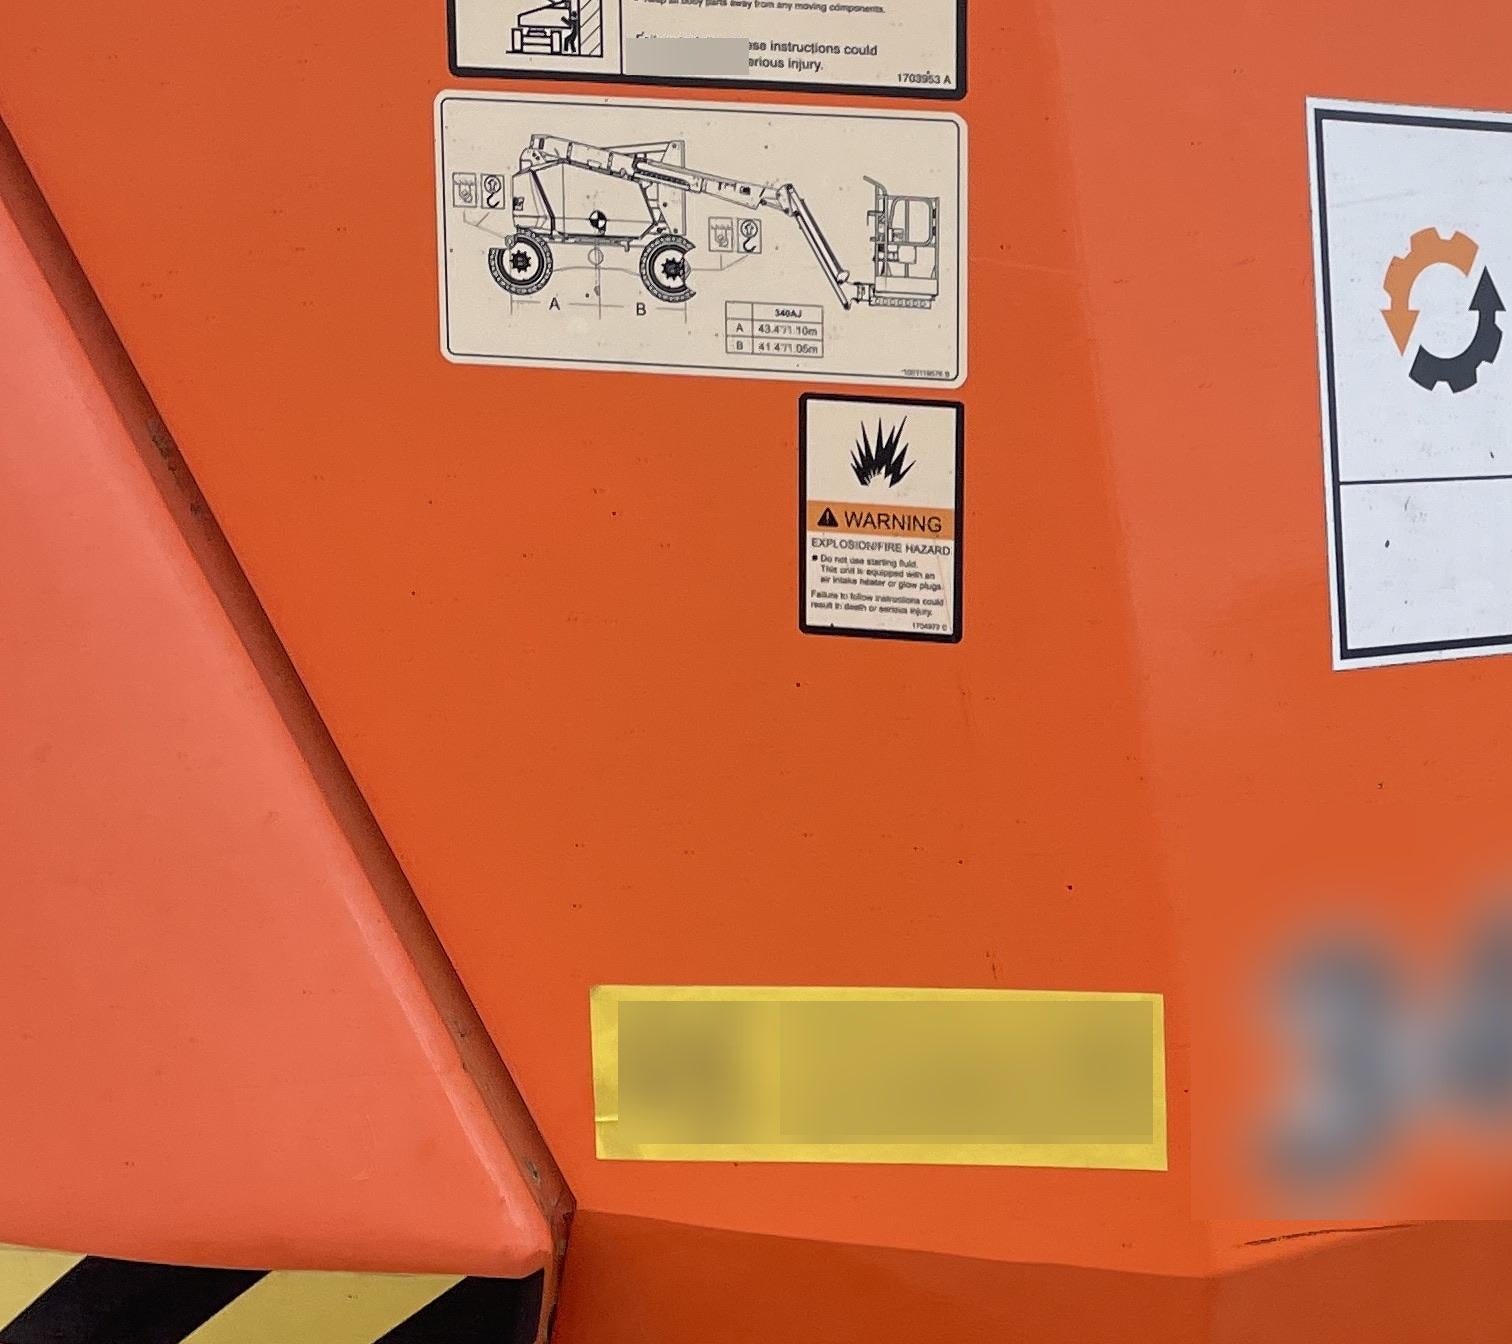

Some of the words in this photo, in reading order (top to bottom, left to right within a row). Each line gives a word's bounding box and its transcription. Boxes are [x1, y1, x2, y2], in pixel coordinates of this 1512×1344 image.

[729, 0, 753, 9] away
[776, 0, 792, 11] any
[794, 0, 827, 12] moving
[828, 2, 886, 14] components.
[770, 39, 841, 56] instructions
[843, 43, 878, 57] could
[748, 56, 785, 69] erious
[787, 56, 825, 73] injury.
[943, 74, 952, 85] A
[549, 296, 560, 311] A
[636, 302, 647, 316] B
[735, 322, 744, 333] A
[735, 341, 744, 351] B
[844, 511, 942, 533] WARNING
[811, 537, 903, 553] EXPLOSION/FIRE
[905, 543, 951, 556] HAZARD
[820, 554, 833, 563] Do
[834, 555, 848, 563] not
[850, 557, 865, 565] use
[866, 558, 897, 568] starting
[821, 565, 837, 574] This
[839, 566, 856, 575] unit
[866, 568, 904, 579] equipped
[906, 570, 923, 578] with
[924, 572, 936, 580] an
[832, 576, 858, 586] intake
[859, 577, 885, 587] heater
[898, 580, 918, 590] glow
[810, 590, 839, 600] Failure
[850, 591, 873, 601] follow
[874, 594, 921, 605] instructions
[922, 596, 944, 606] could
[810, 601, 834, 610] result
[844, 602, 867, 612] death
[878, 605, 908, 614] serious
